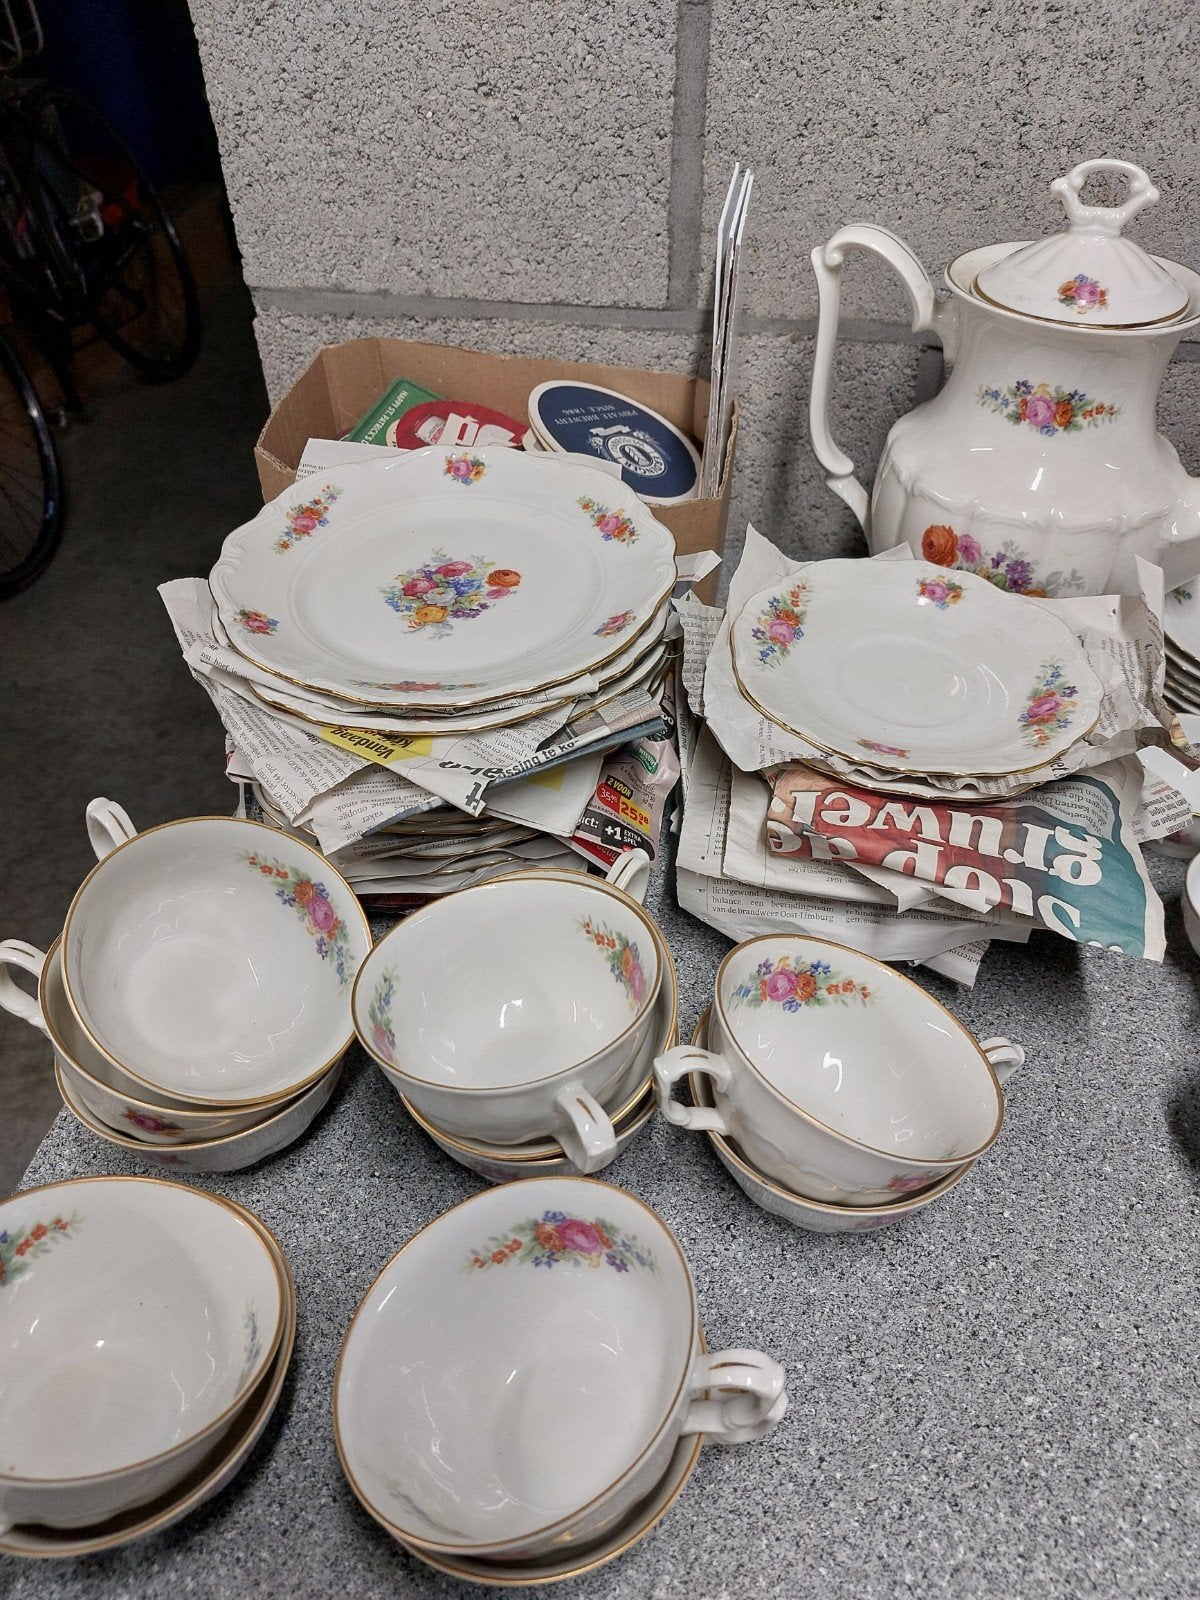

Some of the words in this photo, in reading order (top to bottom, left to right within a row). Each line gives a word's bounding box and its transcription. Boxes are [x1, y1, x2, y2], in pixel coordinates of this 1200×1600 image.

[393, 390, 409, 407] HAPPY
[554, 412, 599, 425] BREWERY
[602, 408, 638, 420] PRIVATE
[365, 410, 388, 441] PATRICK'S
[624, 456, 660, 476] ERDINGER
[330, 727, 397, 761] Vandaag
[614, 780, 632, 797] VOOR
[1053, 795, 1090, 816] Katrien
[623, 835, 638, 847] SPEL
[624, 828, 643, 843] EXTRA
[771, 900, 834, 913] bevrijdingsteam
[780, 911, 834, 923] Oost-Limburg
